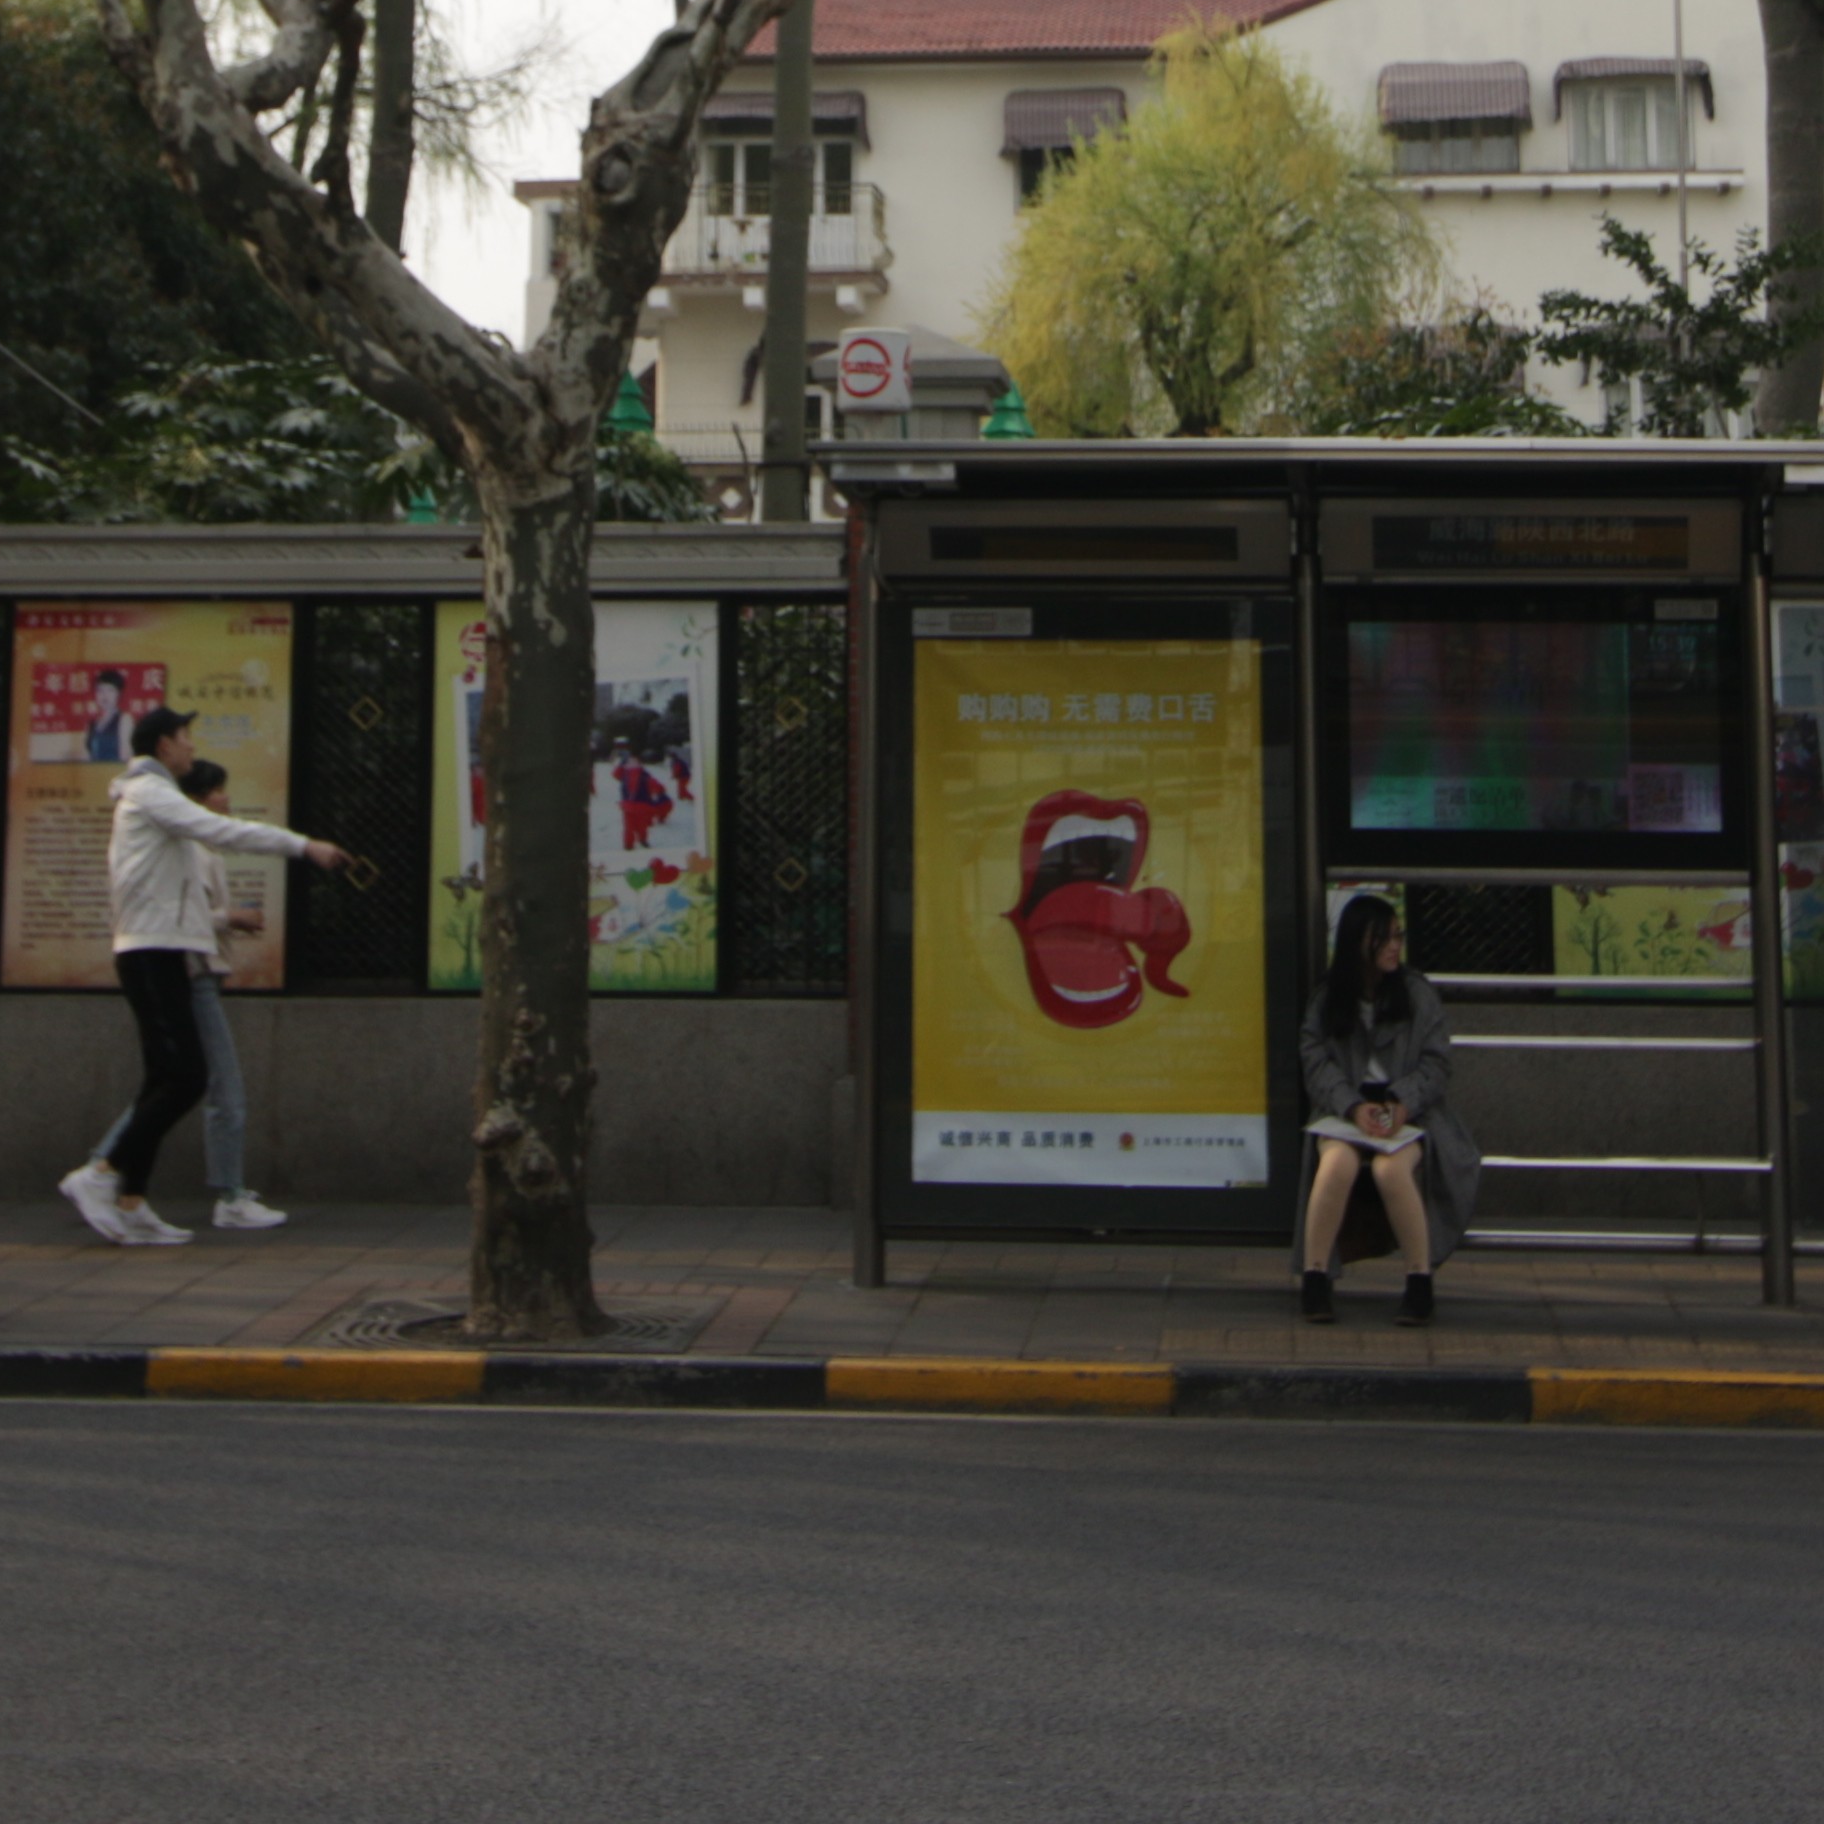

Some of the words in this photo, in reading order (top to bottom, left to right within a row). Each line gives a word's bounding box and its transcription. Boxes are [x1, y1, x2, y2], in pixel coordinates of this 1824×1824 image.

[957, 693, 1050, 723] 购购购
[1062, 692, 1217, 723] 无需费口舌
[939, 1130, 1012, 1149] 诚信兴商
[1021, 1130, 1095, 1149] 品质消费
